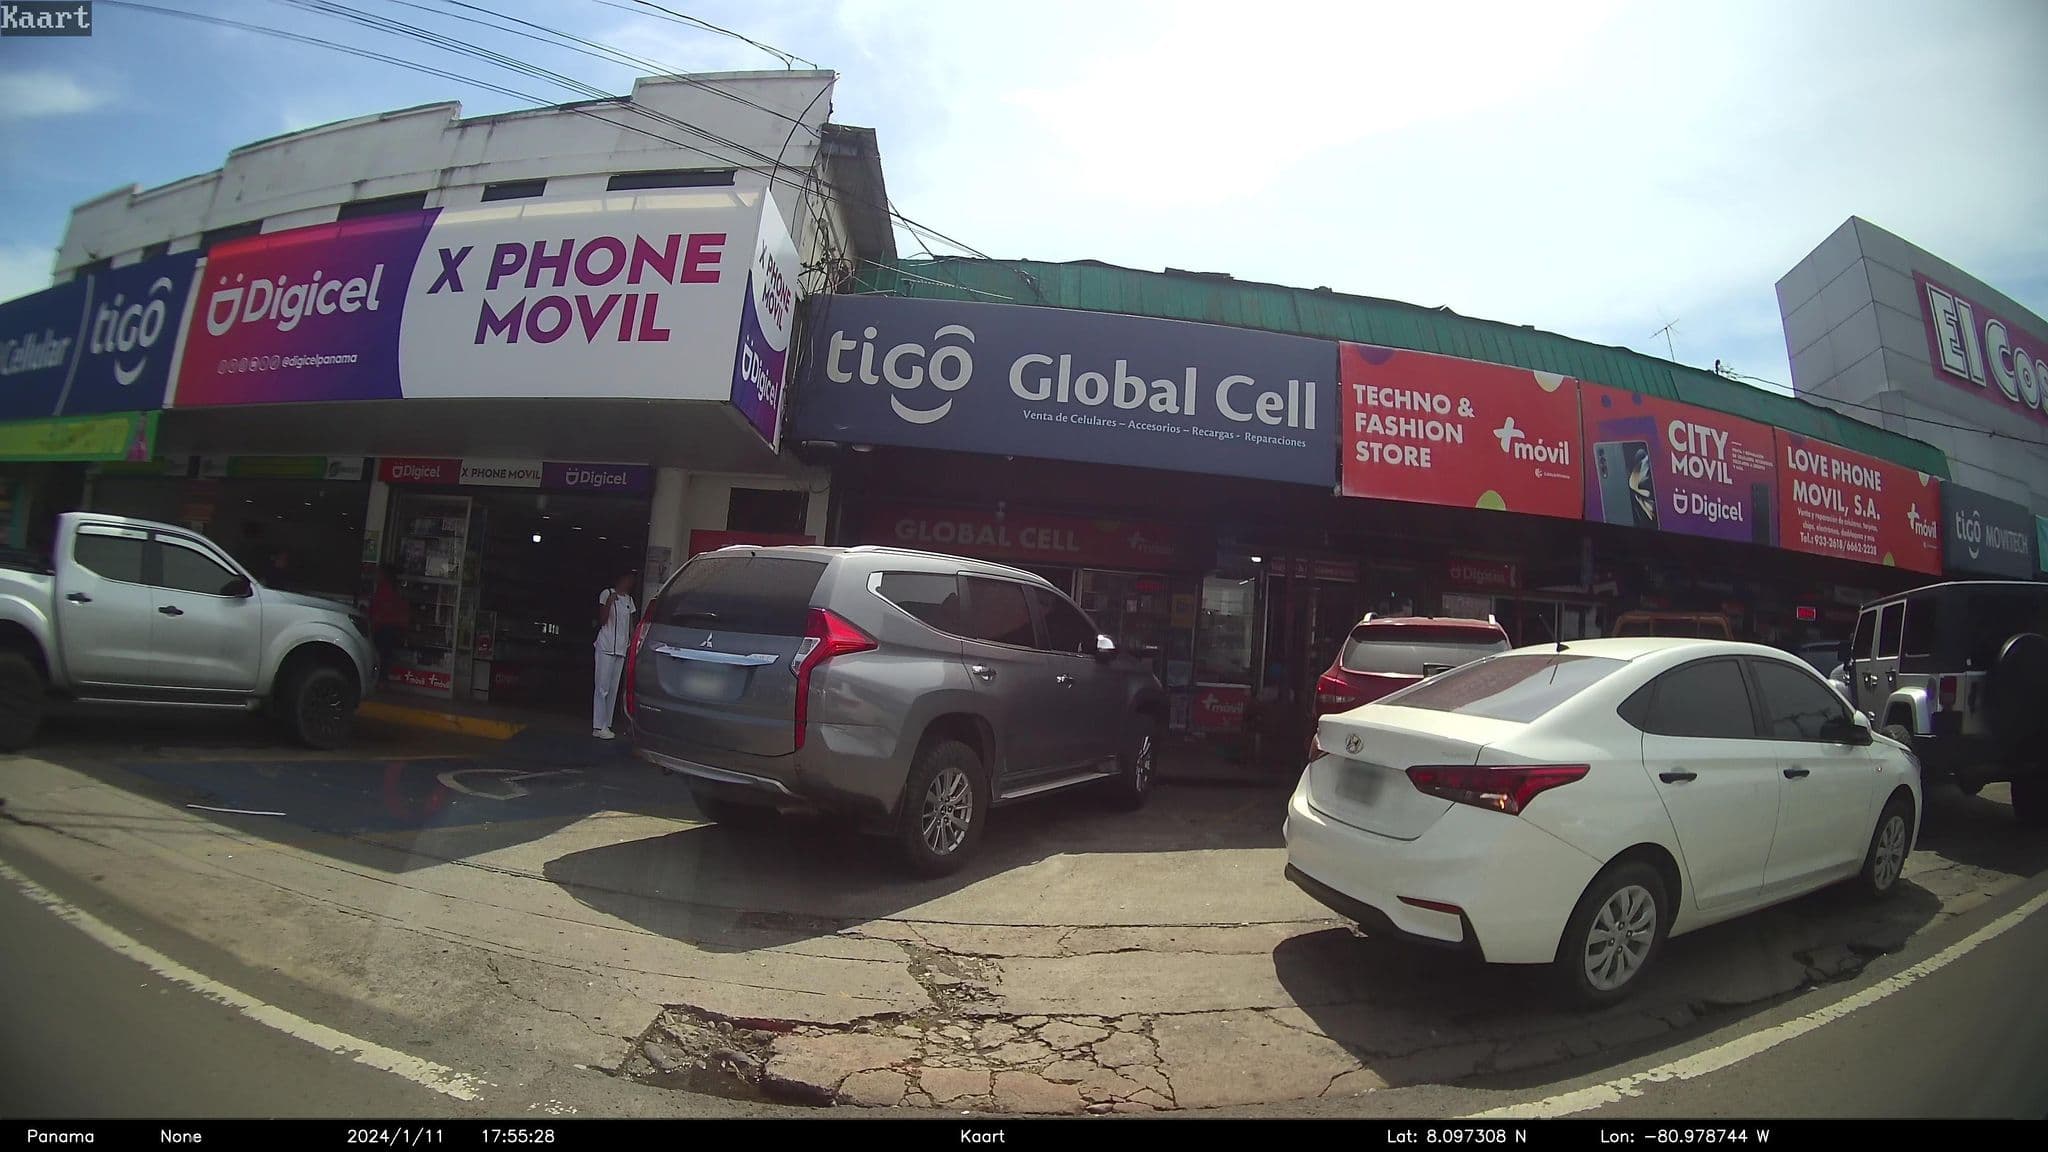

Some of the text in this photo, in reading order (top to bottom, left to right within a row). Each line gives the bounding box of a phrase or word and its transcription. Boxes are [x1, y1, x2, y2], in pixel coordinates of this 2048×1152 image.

[426, 233, 728, 294] X PHONE
[758, 240, 792, 314] X PHONE
[241, 264, 384, 332] Digicel
[762, 282, 783, 332] MOVIL
[474, 293, 672, 345] MOVIL
[1926, 282, 1987, 388] El
[282, 354, 358, 369] @digicelpanama
[751, 352, 779, 410] Digicel
[1008, 353, 1316, 430] Global Cell
[1353, 384, 1475, 418] TECHNO &
[1023, 409, 1054, 422] Venta
[1056, 412, 1068, 423] de
[1070, 414, 1117, 428] Celulares
[1128, 419, 1182, 434] Accesorios
[1192, 426, 1235, 440] Recargas
[1245, 432, 1307, 448] Reparaciones
[1355, 412, 1463, 444] FASHION
[1668, 420, 1729, 460] CITY
[403, 464, 441, 479] Digicel
[1355, 440, 1431, 468] STORE
[1671, 452, 1733, 485] MOVIL
[1787, 446, 1829, 478] LOVE
[1831, 458, 1882, 492] PHONE
[460, 467, 541, 481] X PHONE MOVIL
[580, 470, 628, 487] Digicel
[1691, 493, 1743, 523] Digicel
[1792, 479, 1881, 521] MOVIL, S.A.
[893, 519, 1081, 552] GLOBAL CELL
